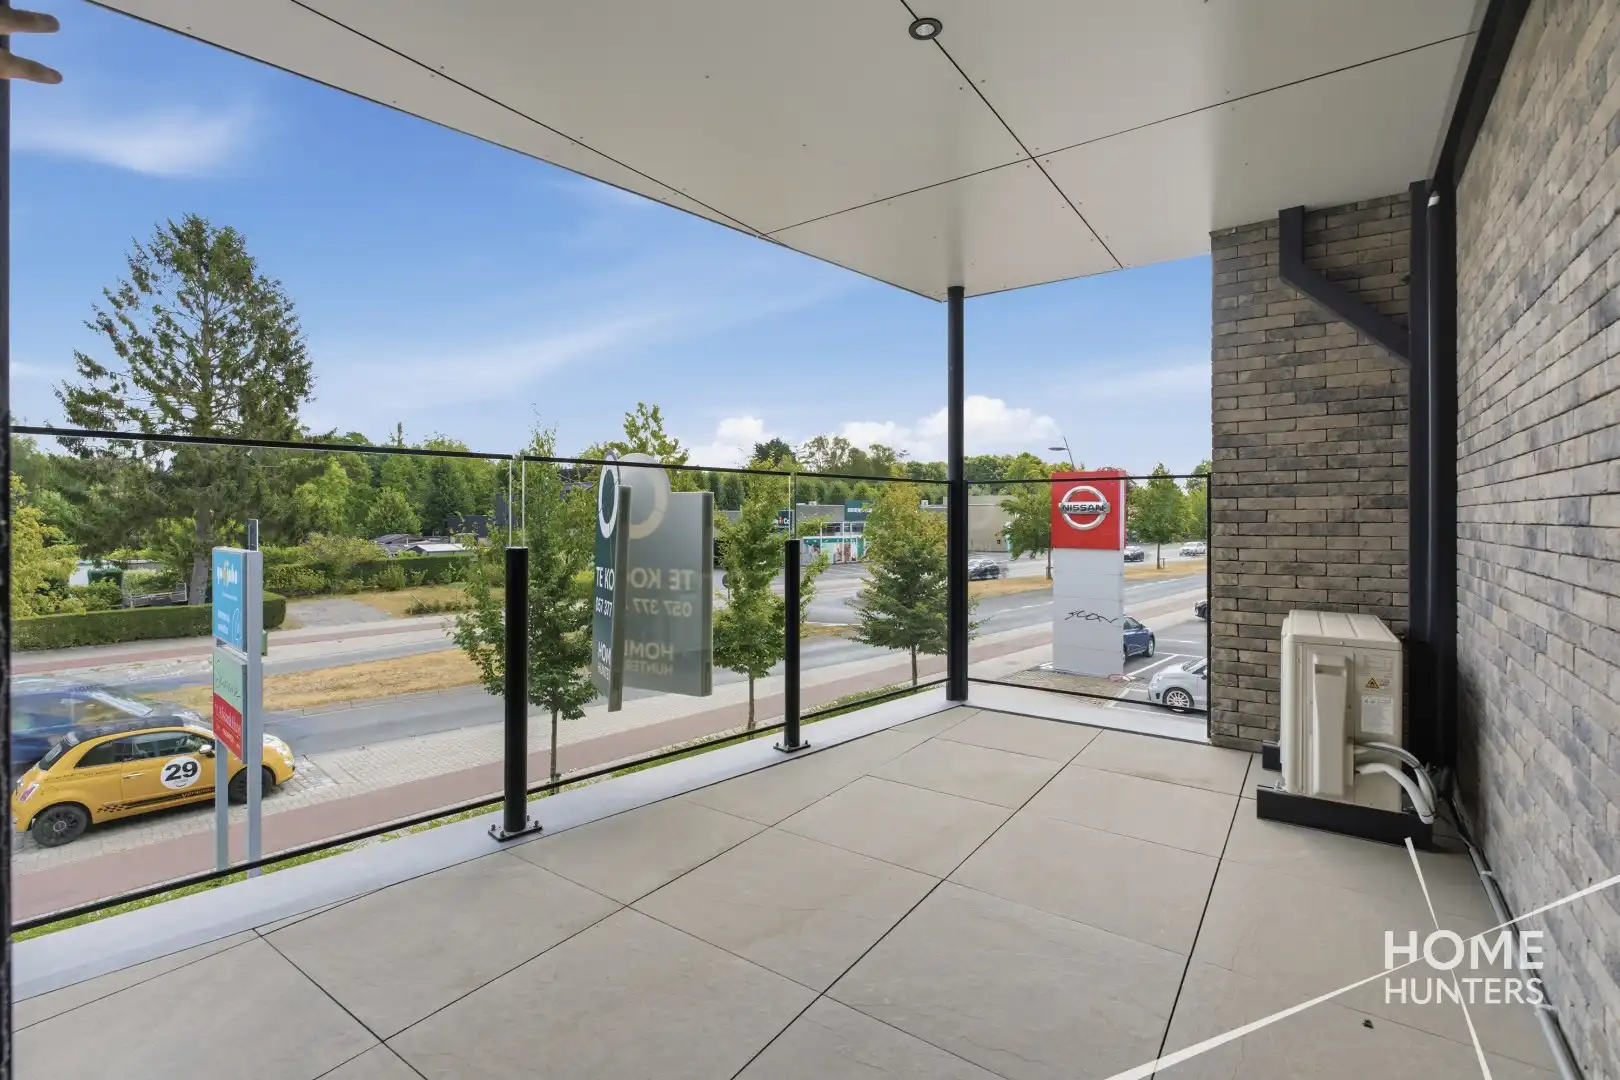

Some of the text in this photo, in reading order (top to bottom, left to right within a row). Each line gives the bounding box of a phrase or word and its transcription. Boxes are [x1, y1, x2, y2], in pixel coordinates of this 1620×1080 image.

[1062, 503, 1105, 512] NISSAN
[596, 566, 604, 588] TE
[165, 761, 198, 782] 29
